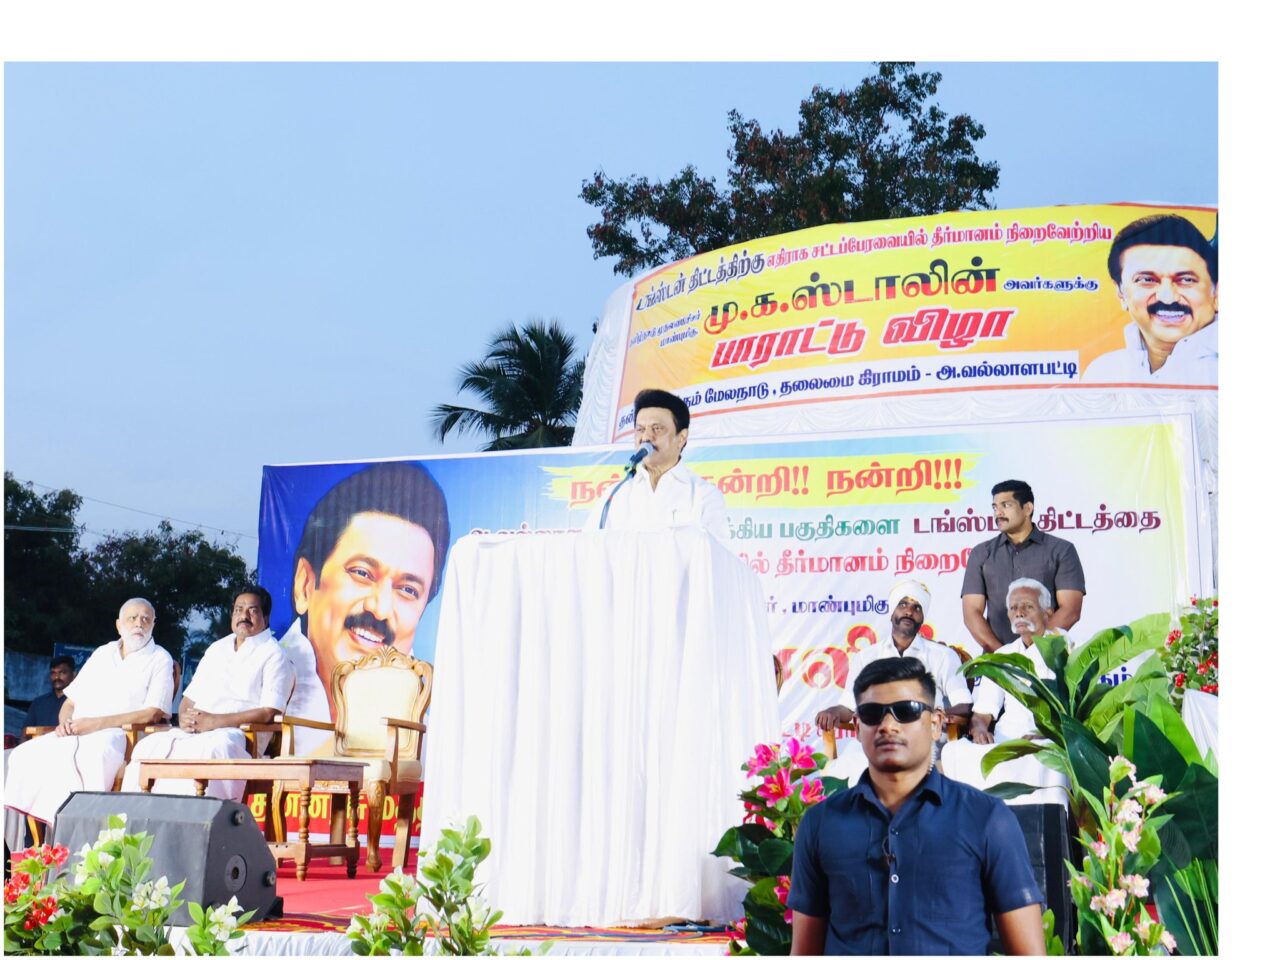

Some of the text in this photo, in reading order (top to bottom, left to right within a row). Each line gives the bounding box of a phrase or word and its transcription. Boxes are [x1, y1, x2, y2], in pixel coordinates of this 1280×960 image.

[688, 250, 765, 294] திட்டத்திற்கு
[767, 249, 808, 268] எதிராக
[812, 228, 927, 257] சட்டப்பேரவையில்
[931, 223, 1003, 247] தீர்மானம்
[1006, 221, 1112, 244] நிறைவேற்றிய
[704, 256, 1000, 335] மு.க.ஸ்டாலின்
[1003, 277, 1098, 293] அவர்களுக்கு
[712, 307, 1014, 368] பாராட்டு விழா
[705, 382, 768, 405] மேலநாடு
[780, 375, 854, 395] தலைமை
[858, 366, 921, 387] கிராமம்
[936, 360, 1078, 381] அ.வல்லாளபட்டி
[826, 459, 962, 497] நன்றி!!!
[780, 515, 900, 541] பகுதிகளை
[1037, 504, 1161, 534] திட்டத்தை
[775, 547, 888, 577] தீர்மானம்
